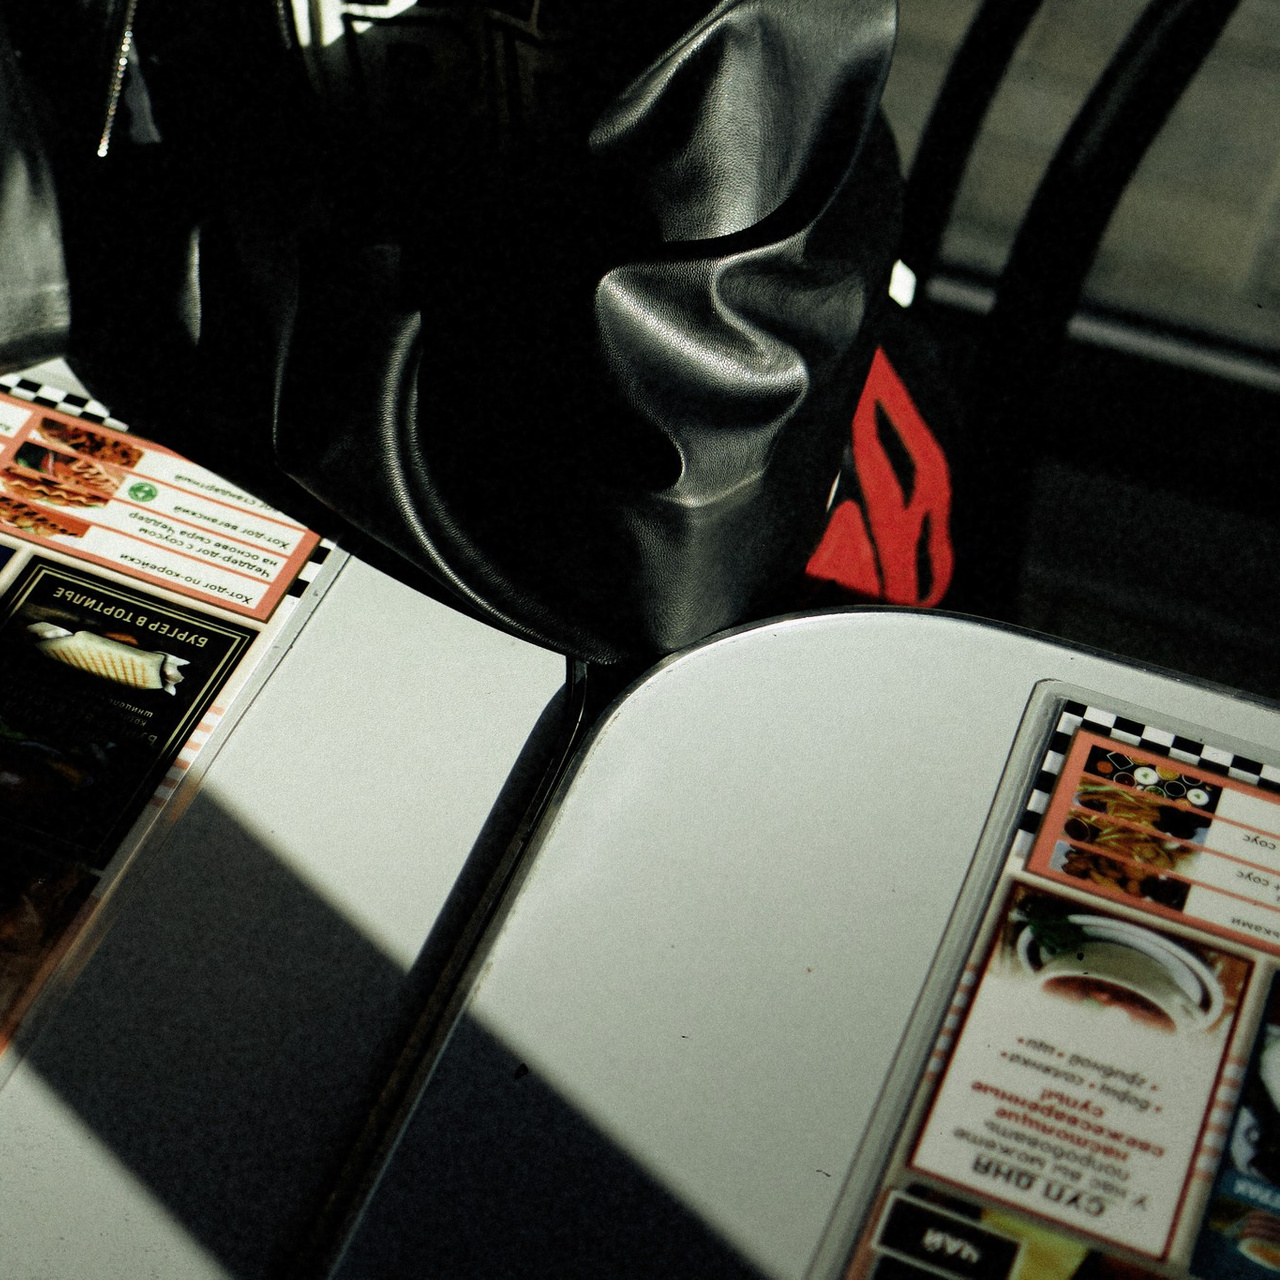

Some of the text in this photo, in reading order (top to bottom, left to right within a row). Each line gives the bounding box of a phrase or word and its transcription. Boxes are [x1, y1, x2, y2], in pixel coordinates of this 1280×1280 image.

[173, 506, 239, 531] веганский
[129, 512, 278, 566] на основе сыра Чеддер
[138, 527, 184, 546] соусом
[242, 529, 290, 549] Хот-дог
[120, 554, 253, 604] Хот-дог по-корейски
[197, 548, 270, 577] Чеддер-дог
[53, 587, 208, 648] БУРГЕР В ТОРТИЛЬЕ
[1243, 835, 1277, 850] соус
[1237, 871, 1270, 887] соус
[973, 1082, 1164, 1156] свежесваренные
[1040, 1090, 1104, 1118] супы!
[954, 1129, 1046, 1169] можете
[996, 1108, 1128, 1161] настоящие
[985, 1122, 1129, 1181] попробовать
[973, 1157, 1105, 1217] СУП ДНЯ
[1132, 1193, 1148, 1211] У
[923, 1229, 979, 1262] ЧАЙ
